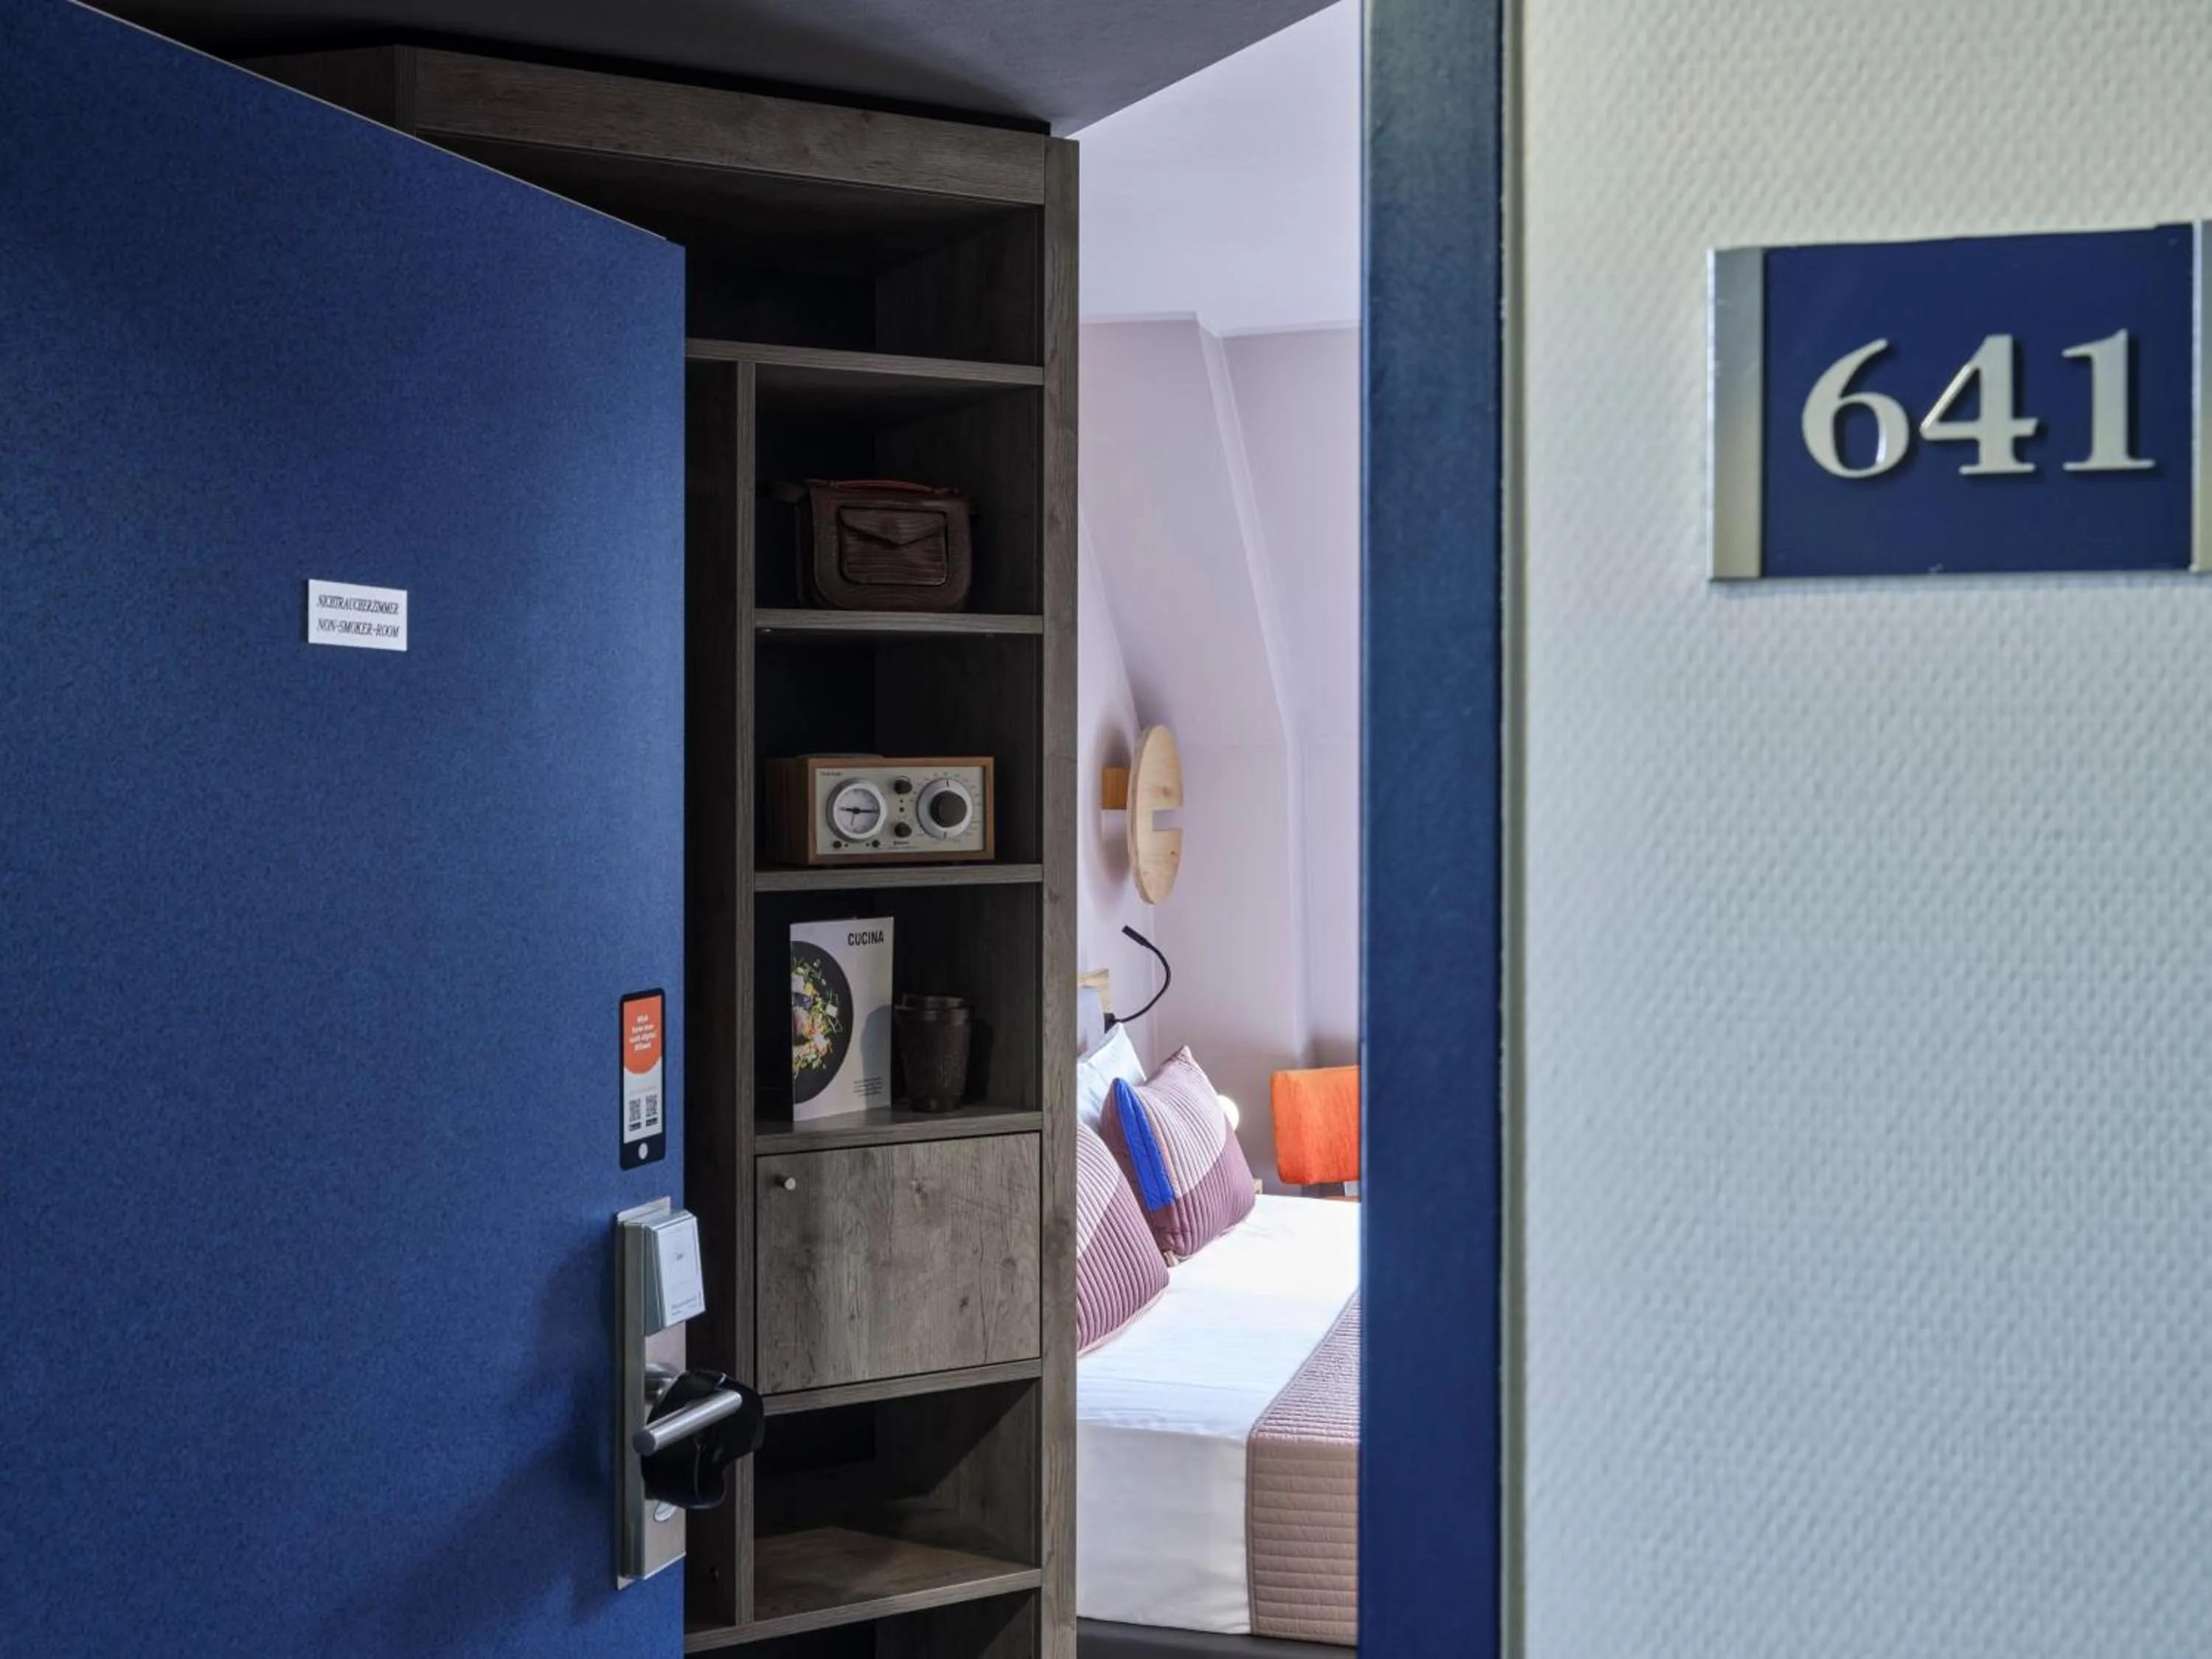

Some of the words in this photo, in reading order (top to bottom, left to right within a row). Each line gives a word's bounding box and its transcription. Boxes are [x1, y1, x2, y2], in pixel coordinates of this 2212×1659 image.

[1801, 328, 2156, 479] 641
[317, 594, 400, 615] NICHTRAUCHERZIMMER
[317, 618, 400, 639] NON-SMOKER-ROOM
[848, 930, 884, 946] CUCINA
